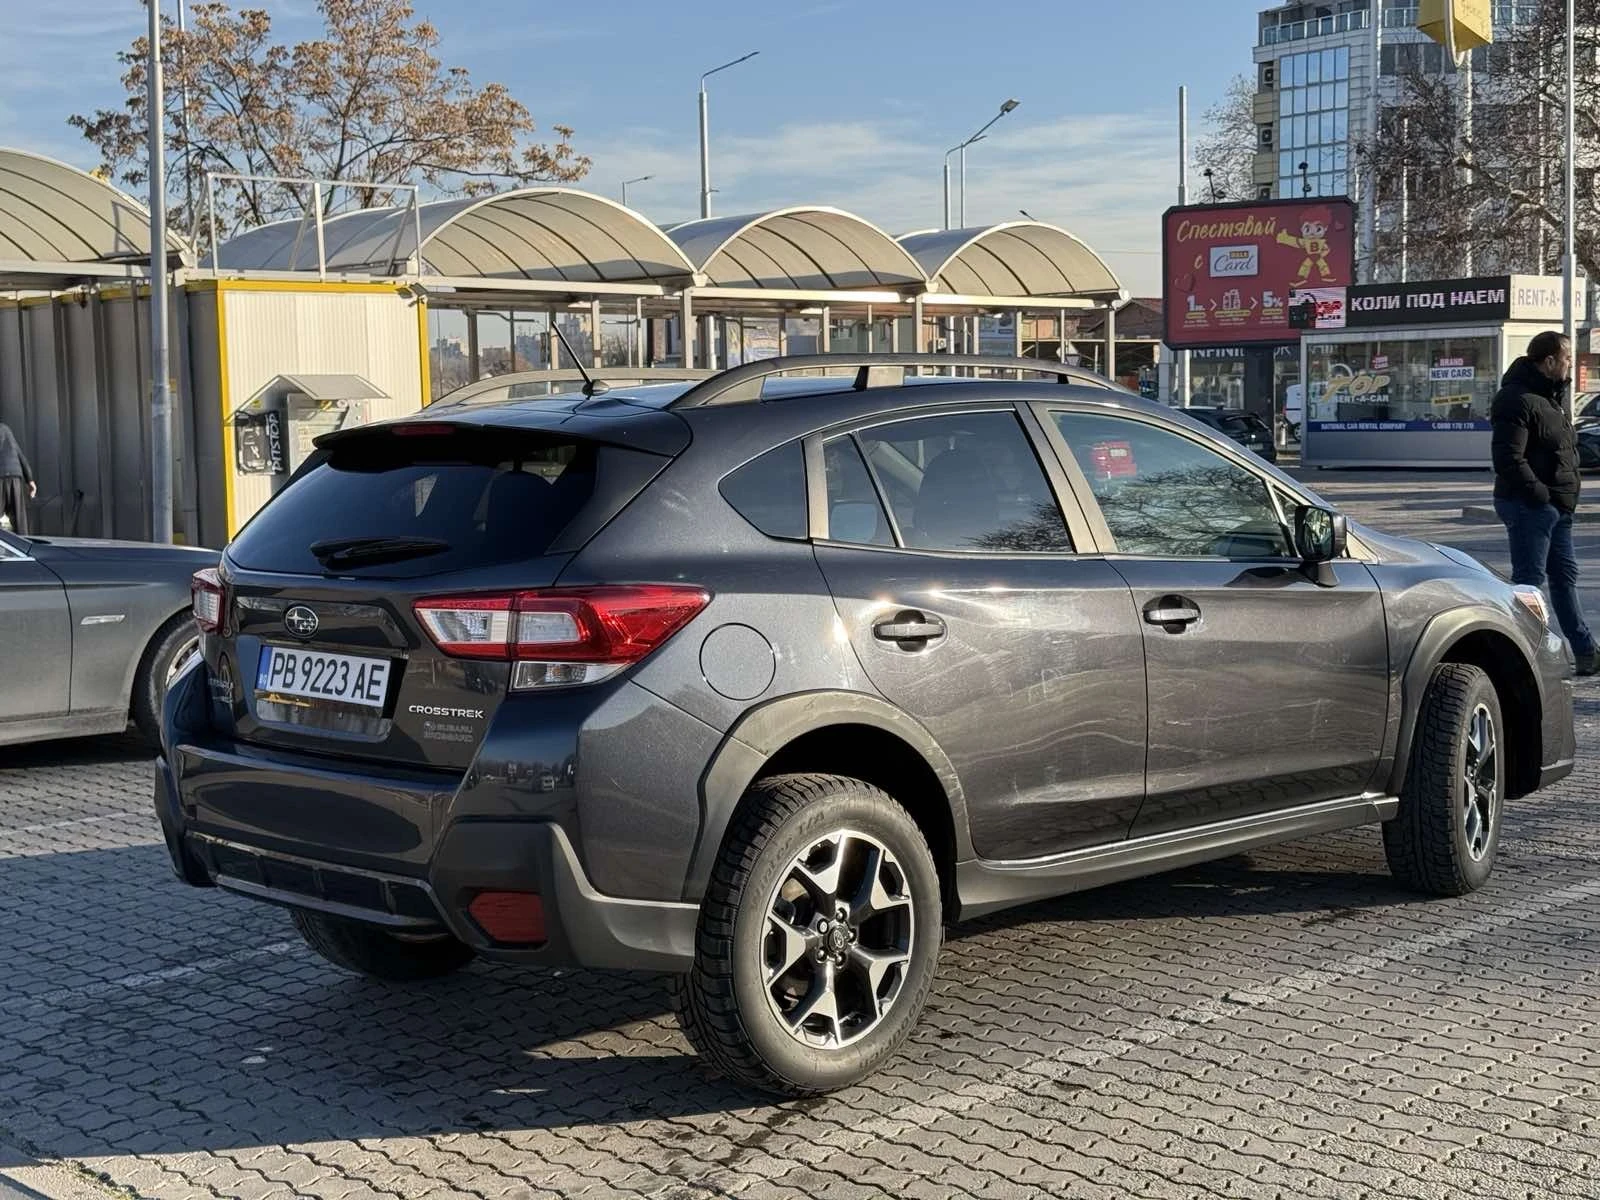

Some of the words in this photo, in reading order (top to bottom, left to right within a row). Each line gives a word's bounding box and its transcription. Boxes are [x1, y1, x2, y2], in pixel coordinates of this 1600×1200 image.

[1177, 215, 1277, 242] Спестявай
[1214, 254, 1253, 272] Card
[1351, 294, 1400, 311] КОЛИ
[1406, 292, 1445, 309] ПОД
[1450, 288, 1505, 306] НАЕМ
[1431, 370, 1450, 379] NEW
[1451, 369, 1473, 378] CARS
[269, 413, 282, 472] PITSTOP
[269, 652, 297, 688] PB
[301, 656, 350, 695] 9223
[351, 662, 385, 701] AE
[408, 704, 485, 719] CROSSTREK
